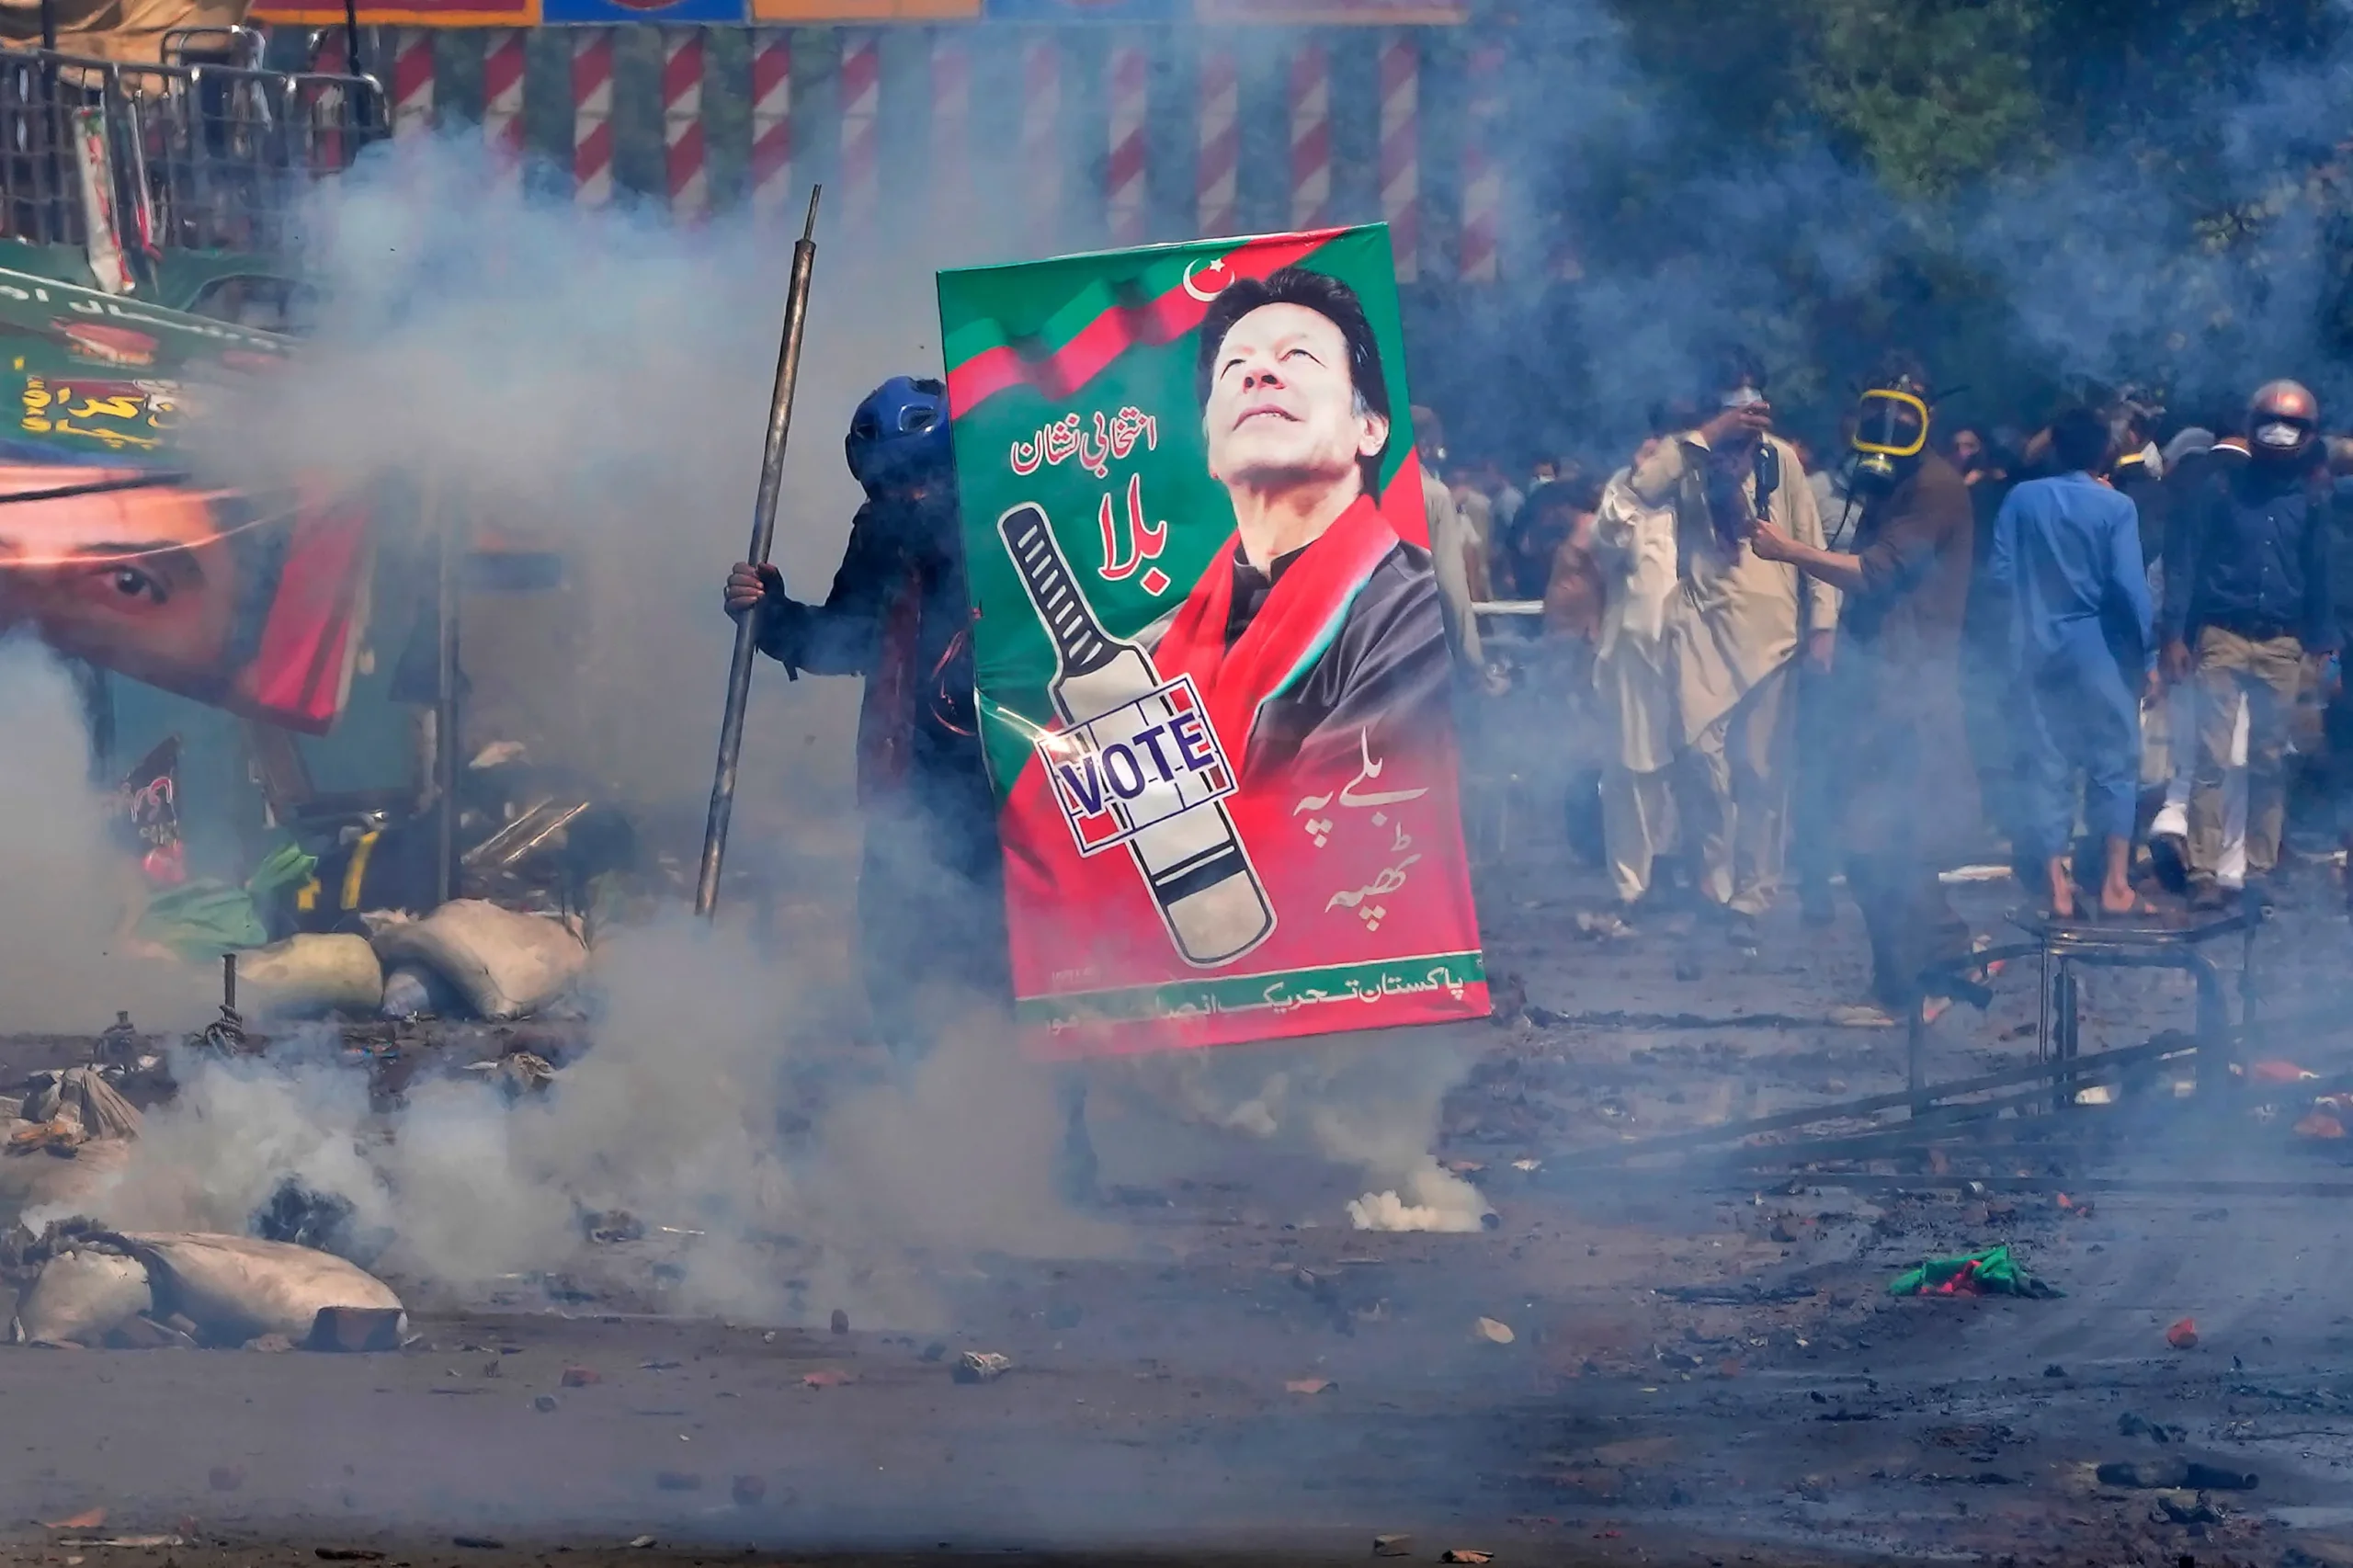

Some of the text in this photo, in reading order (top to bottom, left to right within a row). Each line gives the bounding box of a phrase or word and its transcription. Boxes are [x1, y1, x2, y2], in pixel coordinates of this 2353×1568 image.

[1010, 406, 1158, 478] انتخابی نشان
[1097, 472, 1172, 597] بلا
[1056, 711, 1217, 817] VOTE
[1291, 724, 1430, 849] بلے پہ
[1324, 821, 1423, 933] ٹھپہ
[1217, 978, 1359, 1015] تحریک
[1358, 965, 1465, 1004] پاکستان
